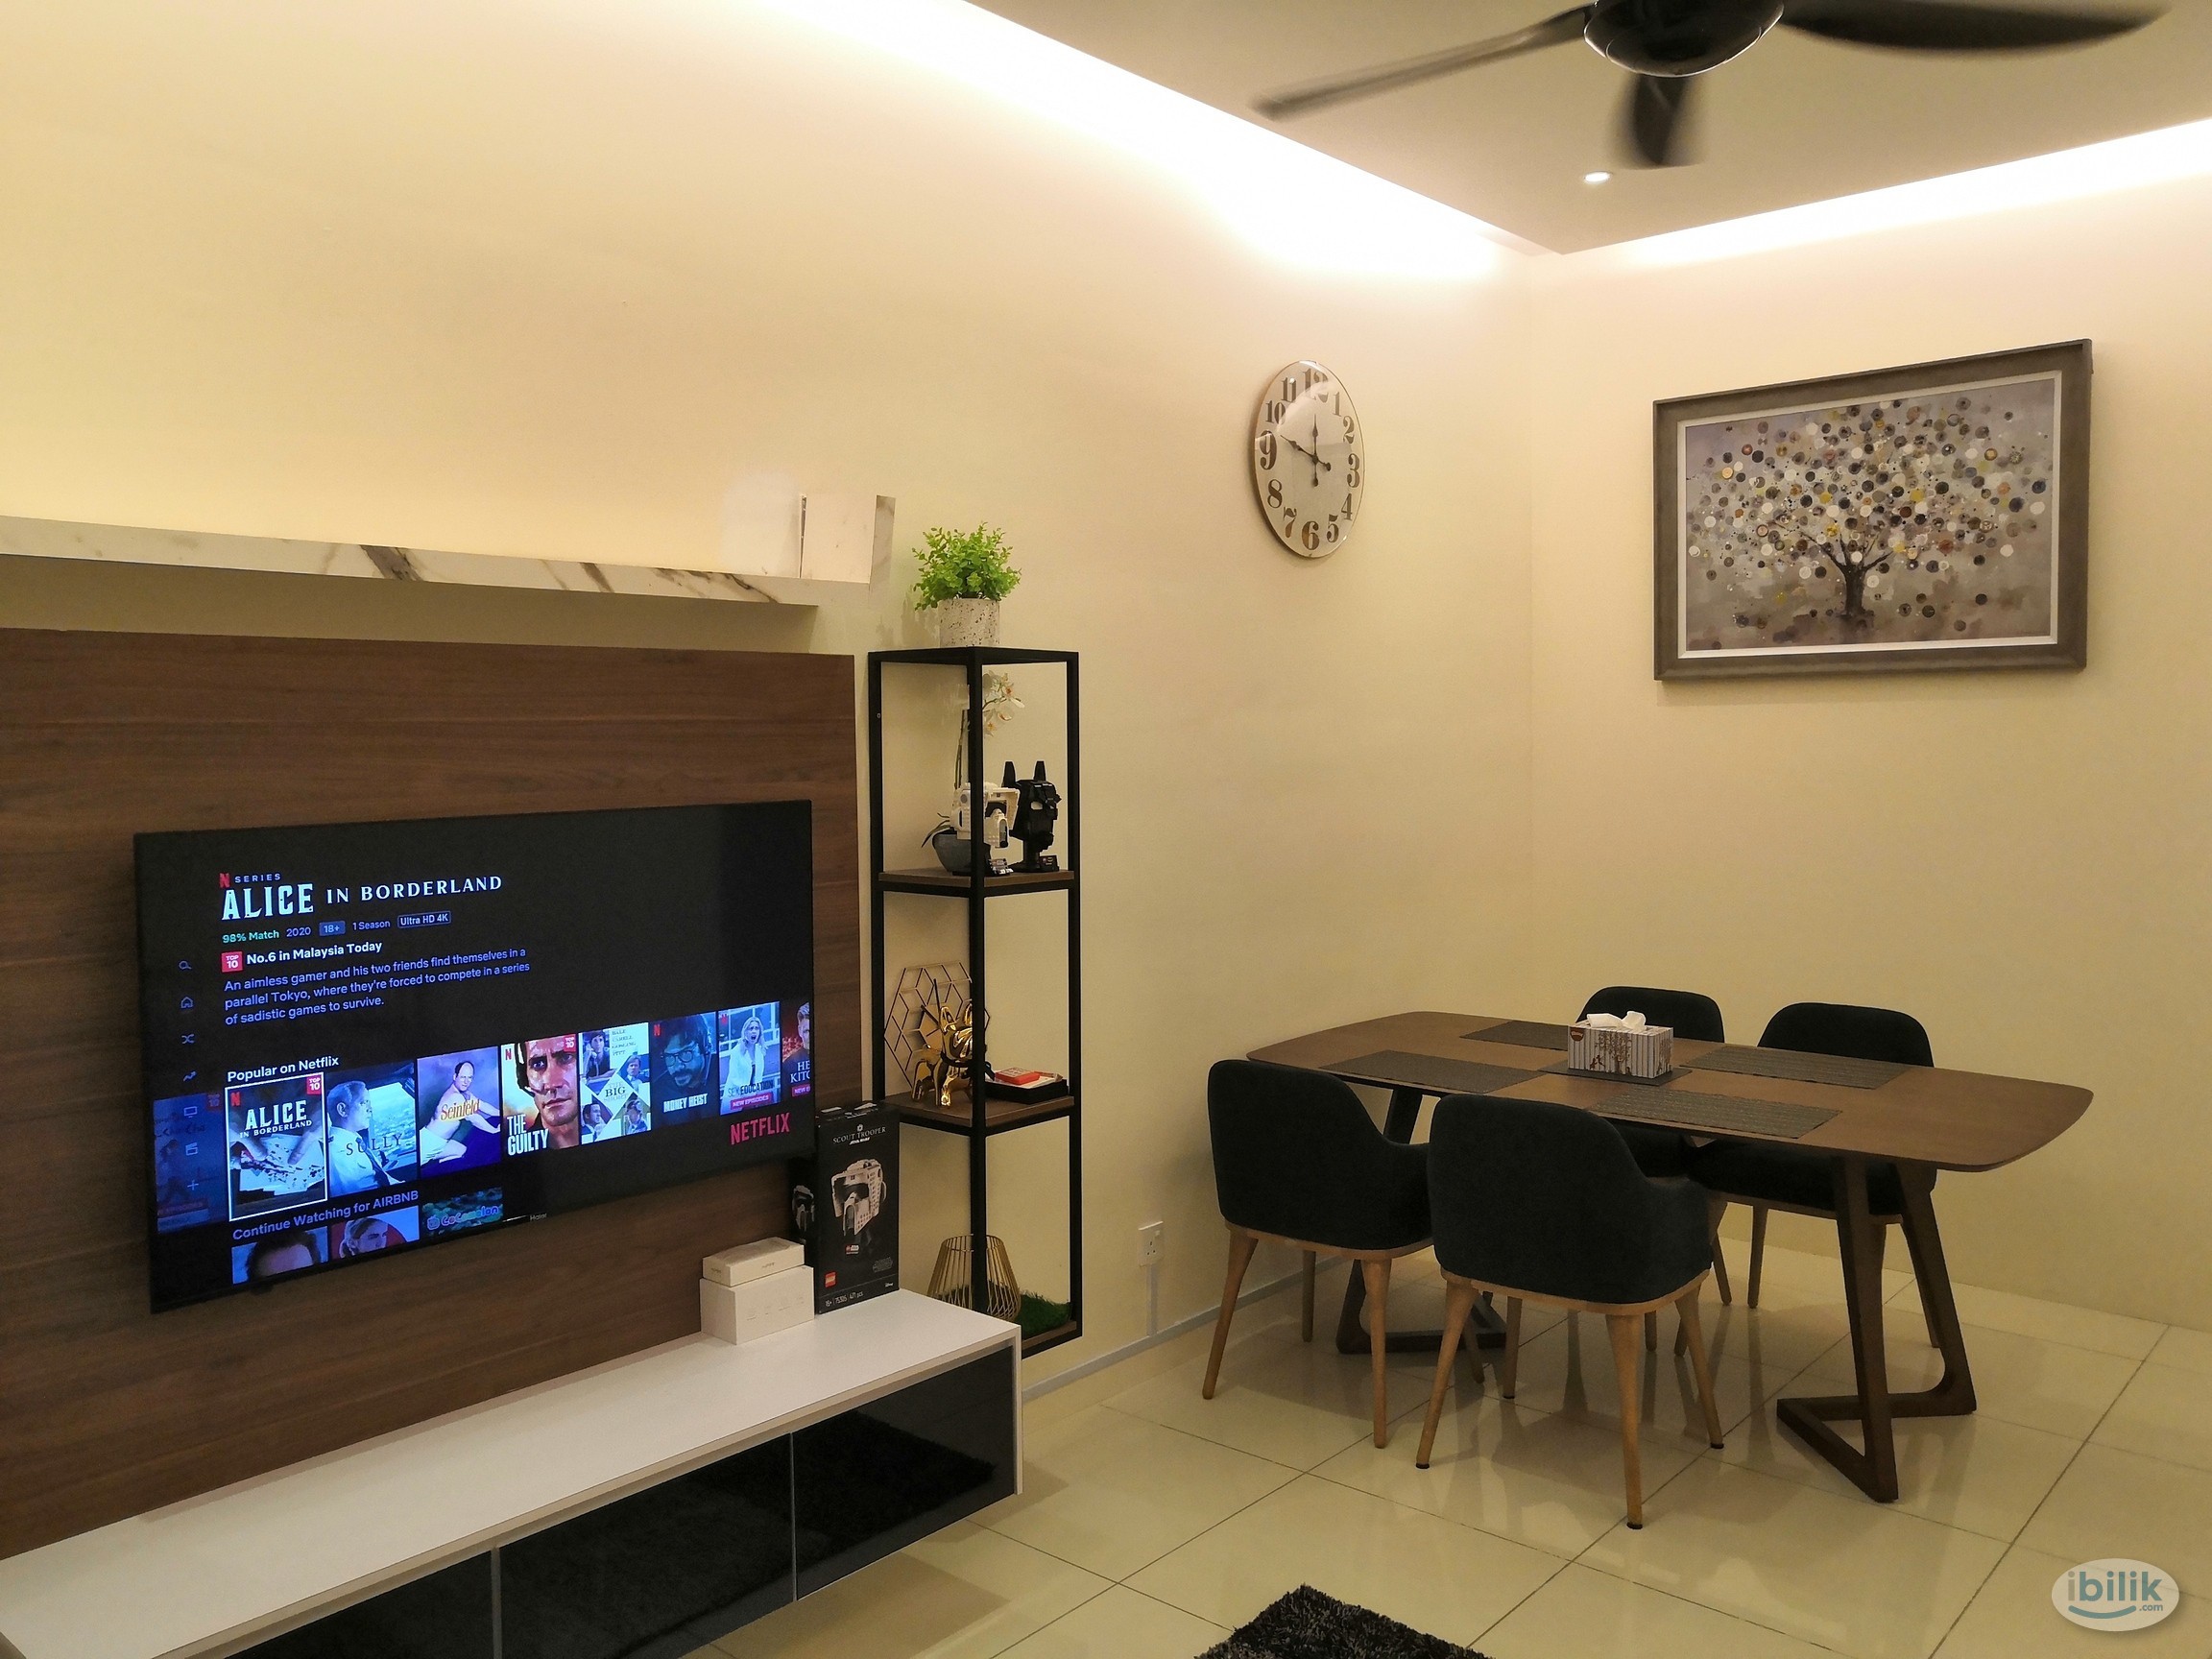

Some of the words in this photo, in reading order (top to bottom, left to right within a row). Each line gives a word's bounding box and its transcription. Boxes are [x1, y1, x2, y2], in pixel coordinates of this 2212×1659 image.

[1281, 376, 1297, 403] 11
[1303, 368, 1329, 403] 12
[1265, 399, 1286, 425] 10
[1333, 391, 1342, 417] 1
[1342, 415, 1355, 445] 2
[1260, 430, 1277, 470] 9
[1347, 452, 1360, 489] 3
[1267, 478, 1283, 509] 8
[1340, 493, 1353, 521] 4
[1283, 506, 1297, 539] 7
[1301, 520, 1319, 551] 6
[1327, 514, 1339, 543] 5
[234, 873, 281, 884] SERIES
[222, 883, 314, 921] ALICE
[326, 887, 349, 904] IN
[361, 876, 502, 902] BORDERLAND
[222, 933, 247, 944] 98%
[249, 929, 279, 941] Match
[286, 926, 311, 938] 2020
[324, 925, 340, 934] 18+
[358, 920, 391, 930] Season
[400, 916, 421, 926] Ultra
[422, 914, 435, 924] HD
[437, 913, 448, 923] 4K
[227, 960, 239, 969] 10
[247, 951, 276, 965] No.6
[278, 950, 290, 961] in
[293, 945, 345, 960] Malaysia
[347, 941, 382, 954] Today
[224, 980, 241, 992] An
[244, 975, 288, 990] aimless
[291, 971, 327, 986] gamer
[329, 966, 350, 979] and
[353, 965, 369, 976] his
[371, 964, 391, 974] two
[393, 958, 429, 972] friends
[431, 955, 450, 967] find
[452, 950, 508, 965] themselves
[509, 948, 518, 958] in
[519, 949, 526, 957] a
[225, 993, 269, 1011] parallel
[271, 991, 311, 1003] Tokyo,
[313, 985, 348, 998] where
[350, 980, 387, 993] they're
[389, 974, 423, 988] forced
[425, 974, 436, 983] to
[438, 968, 481, 982] compete
[483, 967, 493, 976] in
[502, 962, 530, 974] series
[225, 1015, 238, 1025] of
[240, 1008, 286, 1023] sadistic
[288, 1003, 326, 1020] games
[328, 1001, 341, 1011] to
[343, 996, 384, 1010] survive.
[227, 1066, 278, 1083] Popular
[279, 1063, 296, 1074] on
[299, 1055, 339, 1071] Netflix
[309, 1082, 321, 1091] 10
[605, 1086, 626, 1097] BIG
[245, 1099, 307, 1131] ALICE
[441, 1098, 481, 1121] Seinfeld
[253, 1119, 312, 1136] BORDERLAND
[507, 1114, 527, 1136] THE
[730, 1112, 790, 1145] NETFLIX
[832, 1132, 855, 1144] SCOUT
[346, 1132, 403, 1156] SULLY
[507, 1128, 549, 1157] GUILTY
[233, 1219, 291, 1240] Continue
[293, 1206, 351, 1227] Watching
[353, 1202, 371, 1214] for
[373, 1190, 419, 1210] AIRBNB
